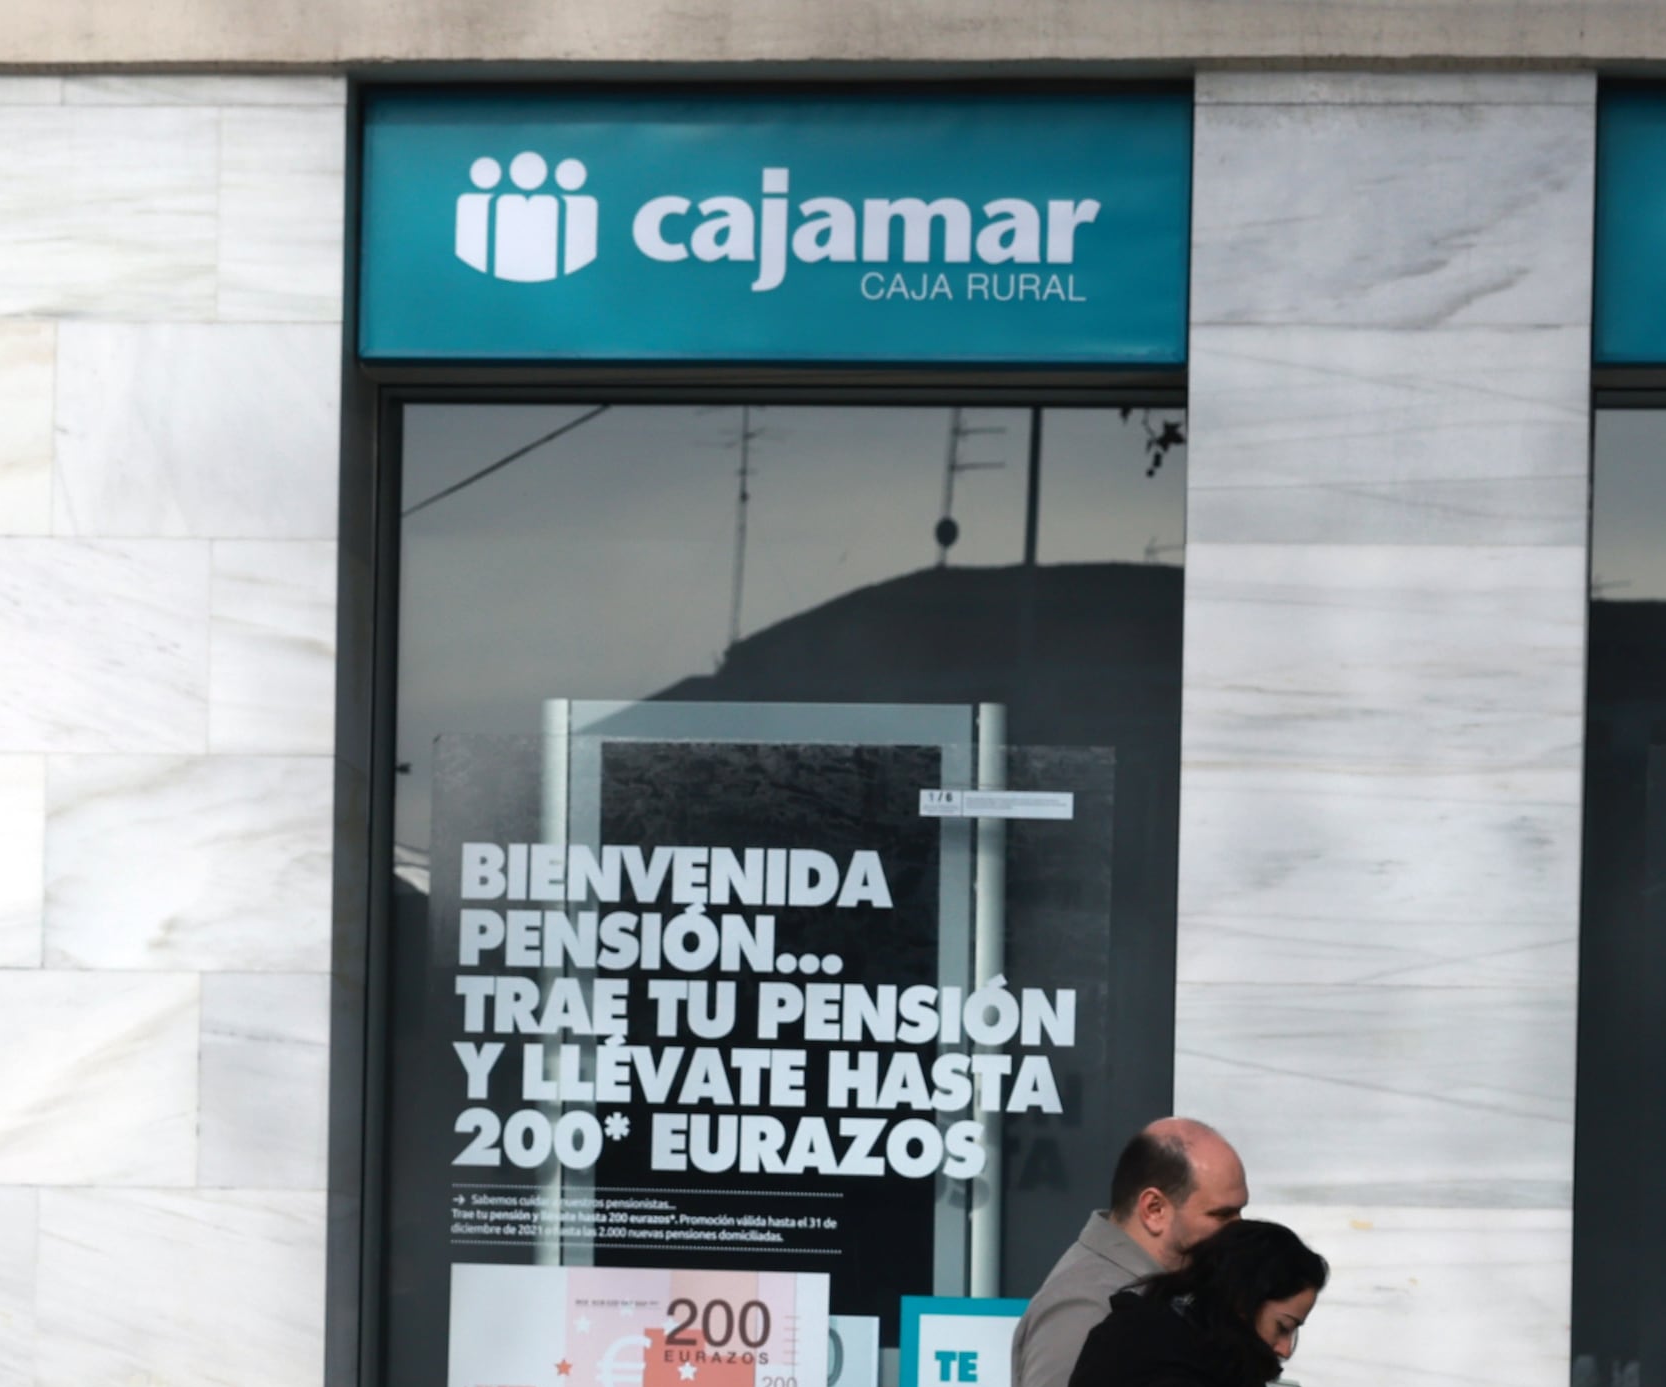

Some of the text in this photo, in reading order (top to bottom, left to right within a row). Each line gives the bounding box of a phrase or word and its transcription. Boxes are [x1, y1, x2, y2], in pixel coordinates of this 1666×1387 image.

[632, 167, 1101, 291] cajamar
[860, 272, 1086, 302] CAJA RURAL
[461, 842, 893, 908] BIENVENIDA
[459, 901, 843, 974] PENSIÓN...
[455, 974, 1075, 1046] TRAE TU PENSIÓN
[453, 1034, 1063, 1113] Y LLÉVATE HASTA
[650, 1112, 986, 1178] EURAZOS
[451, 1208, 475, 1220] Trae
[476, 1209, 489, 1220] tu
[490, 1209, 531, 1223] pensión
[608, 1212, 629, 1223] 200
[680, 1214, 734, 1226] Promoción
[736, 1214, 767, 1227] válida
[768, 1216, 796, 1228] hasta
[809, 1217, 822, 1228] 31
[823, 1217, 837, 1229] de
[471, 1194, 518, 1206] Sabemos
[450, 1223, 501, 1235] diciembre
[503, 1224, 517, 1235] de
[665, 1228, 717, 1241] pensiones
[665, 1298, 771, 1348] 200
[664, 1350, 769, 1365] EURAZOS
[935, 1350, 978, 1382] TE
